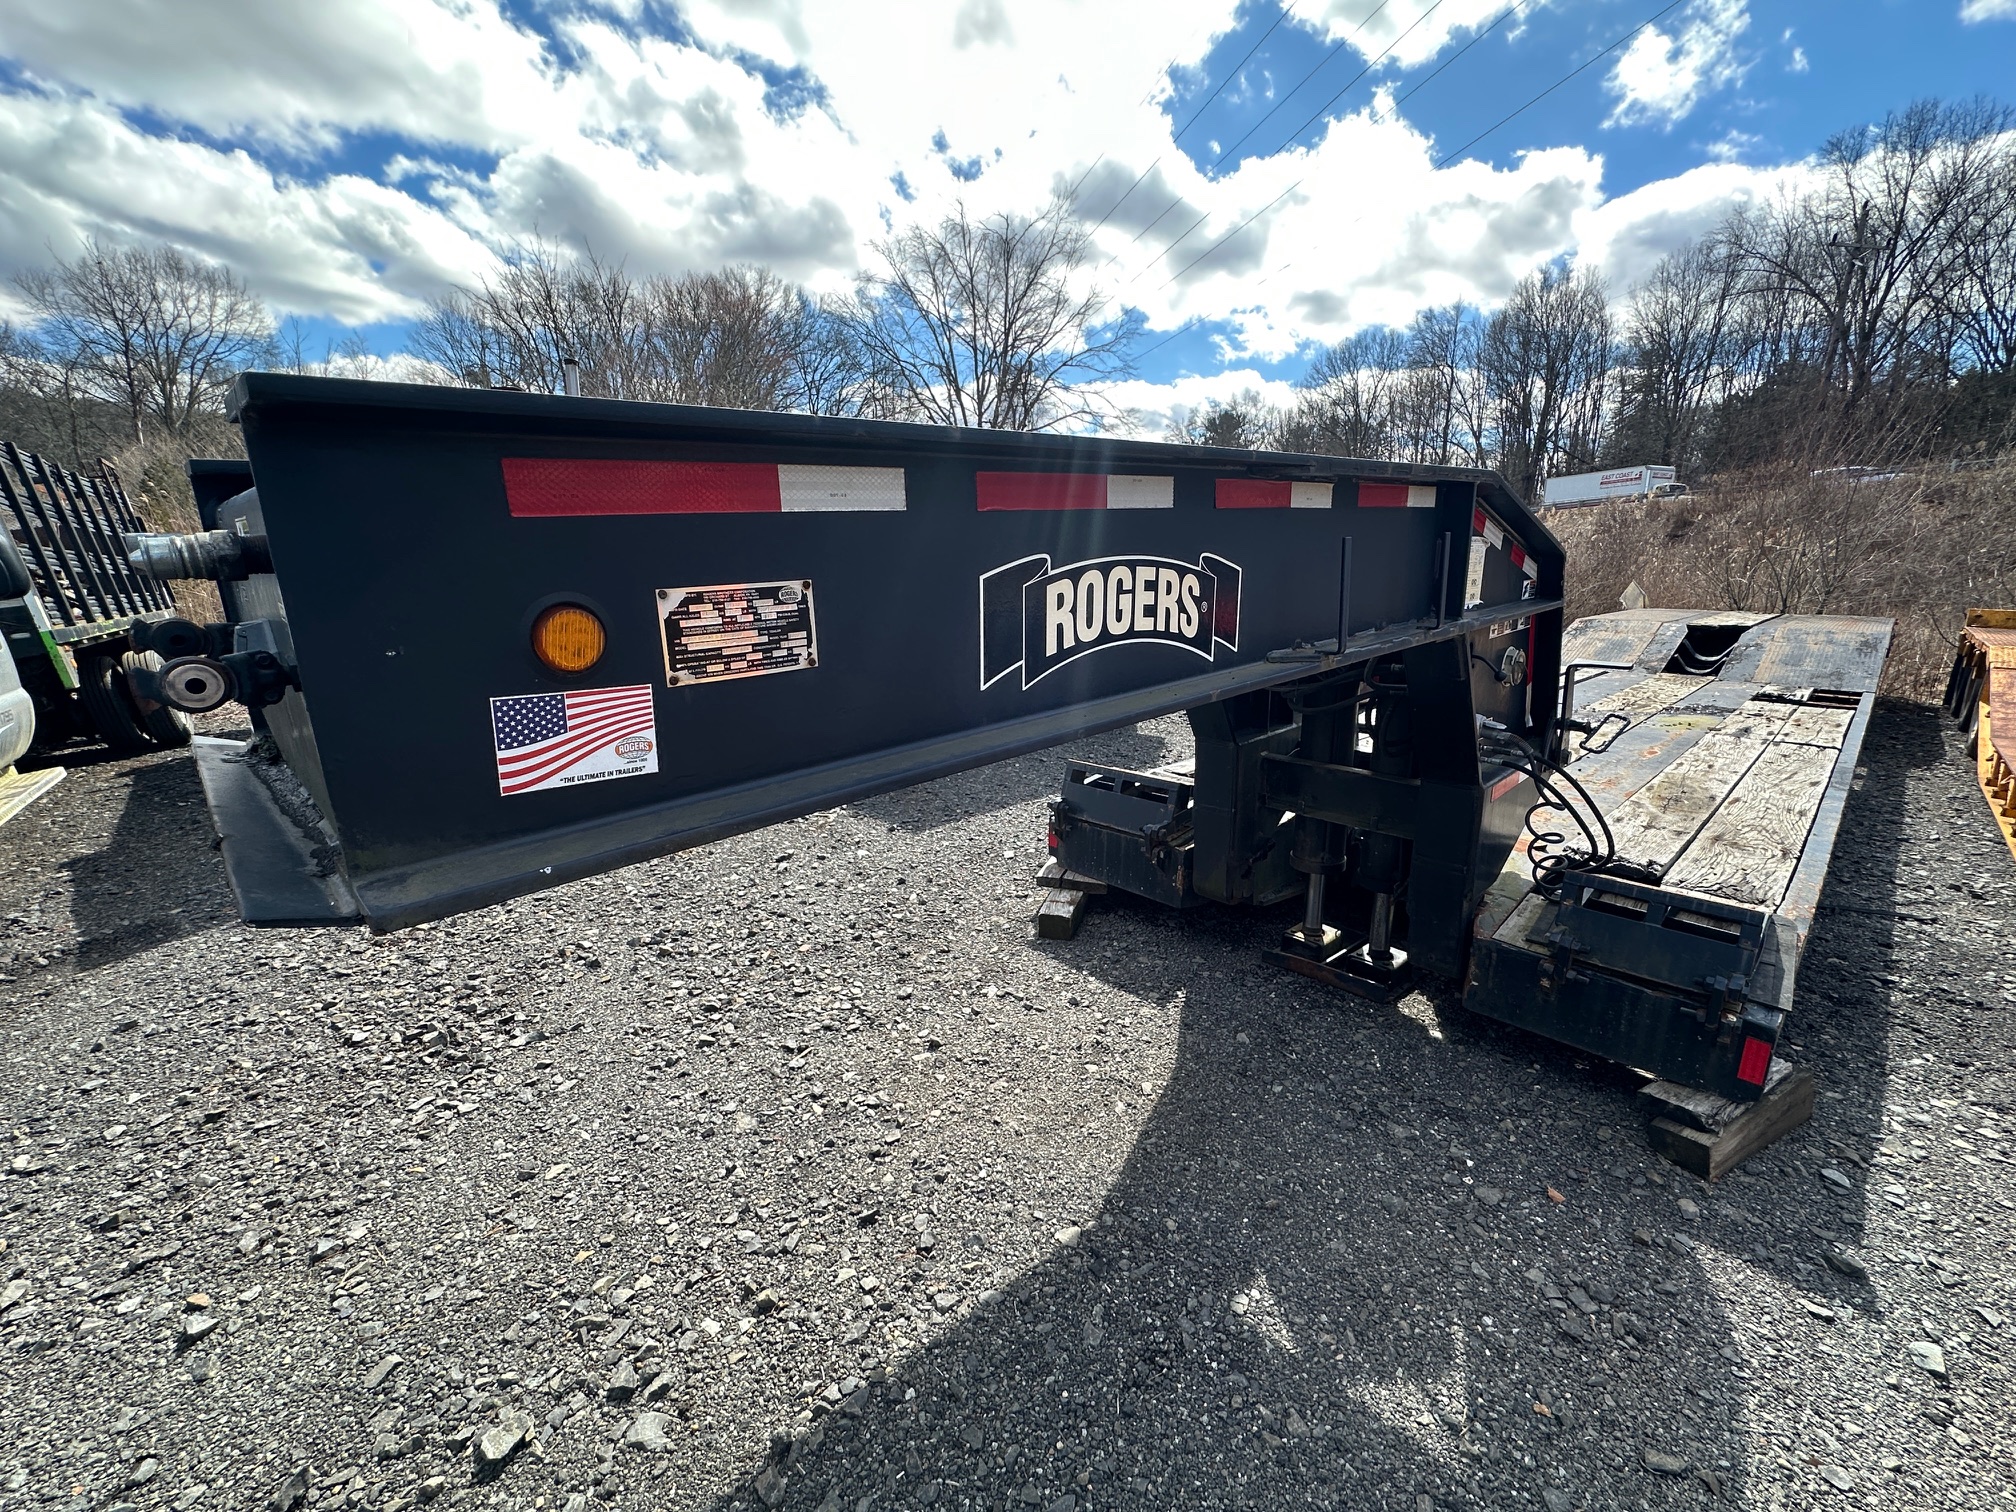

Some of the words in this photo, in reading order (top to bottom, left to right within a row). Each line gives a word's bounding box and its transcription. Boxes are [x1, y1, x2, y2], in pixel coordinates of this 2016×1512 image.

[1615, 471, 1634, 479] COAST
[619, 742, 649, 754] ROGERS
[577, 771, 606, 782] ULTIMATE
[607, 769, 614, 777] IN
